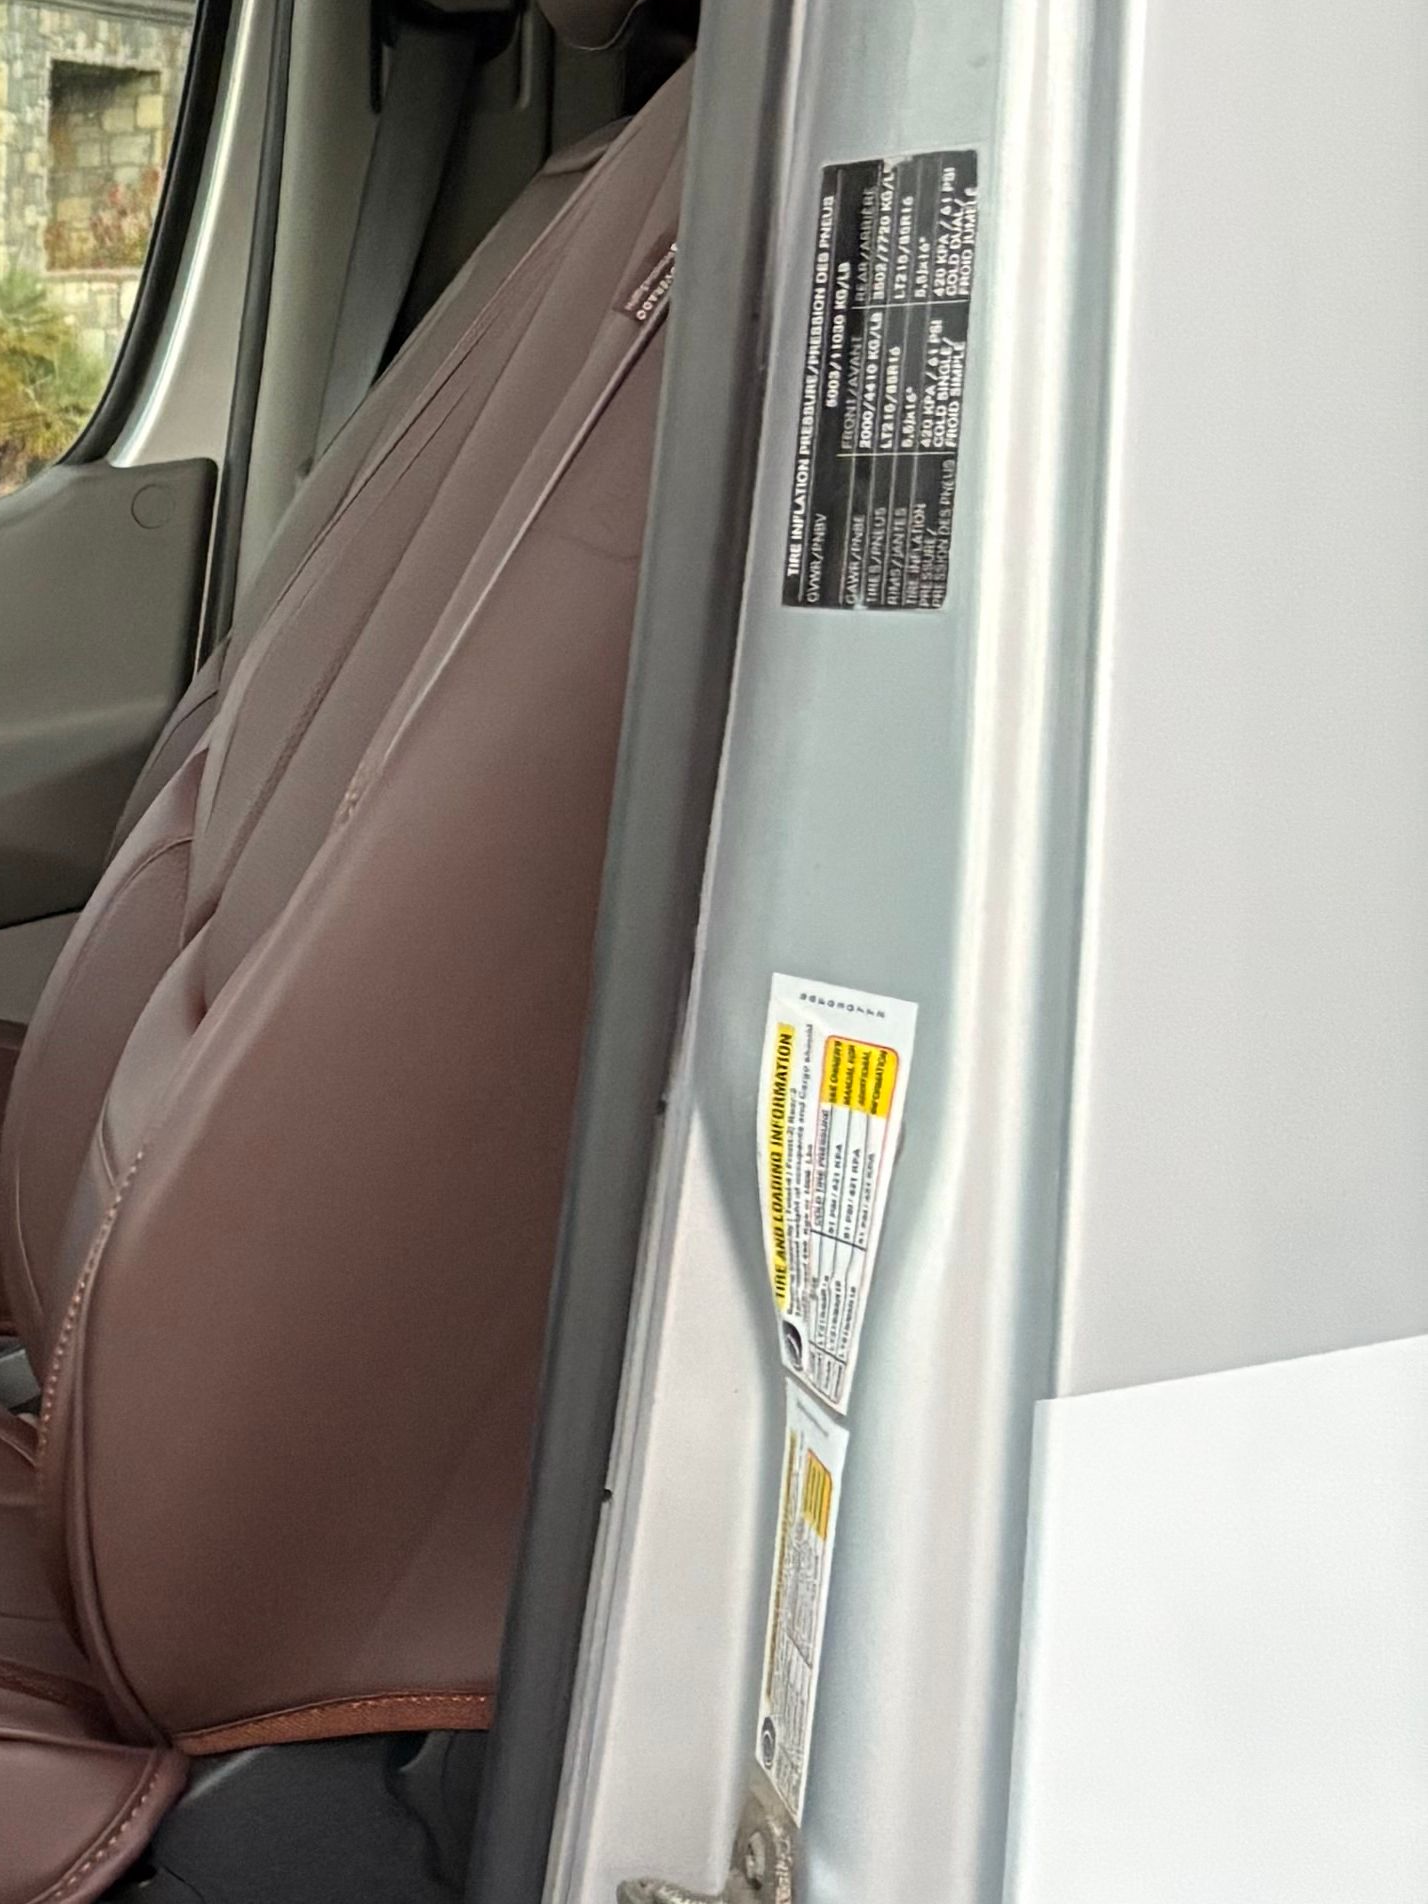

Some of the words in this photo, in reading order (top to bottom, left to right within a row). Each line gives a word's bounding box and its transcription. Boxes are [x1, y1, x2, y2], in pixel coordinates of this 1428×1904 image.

[818, 195, 834, 247] PNEUS
[815, 251, 829, 283] DES
[867, 311, 883, 359] KG/LB
[798, 286, 826, 454] PRESSURE/PRESSION
[859, 363, 879, 448] 2000/4410
[790, 458, 809, 539] INFLATION
[787, 543, 801, 575] TIRE
[770, 1033, 793, 1146] INFORMATION
[770, 1151, 785, 1222] LOADING
[772, 1227, 786, 1260] AND
[774, 1264, 787, 1298] TIRE
